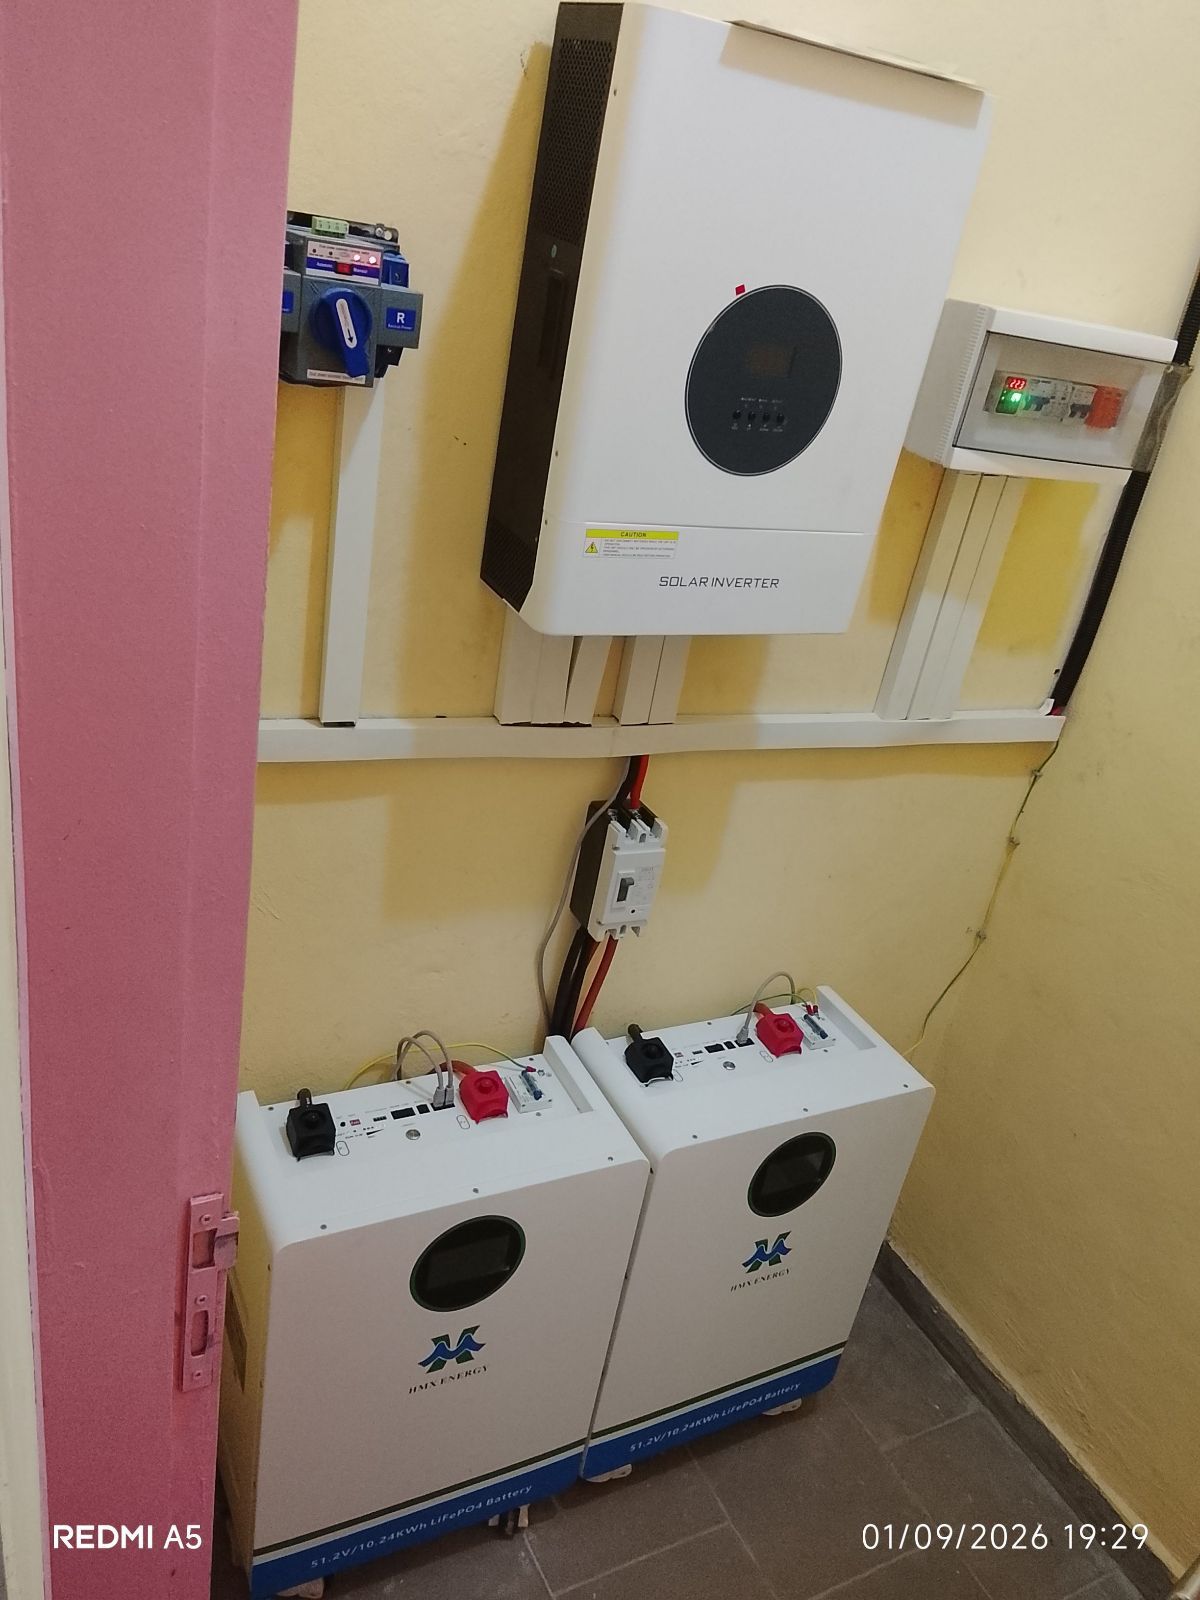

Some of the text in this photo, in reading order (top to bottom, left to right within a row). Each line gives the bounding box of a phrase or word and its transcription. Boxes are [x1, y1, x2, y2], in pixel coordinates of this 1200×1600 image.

[396, 312, 405, 324] R
[659, 576, 780, 588] SOLAR INVERTER
[754, 1267, 790, 1285] ENERGY
[408, 1365, 488, 1394] HMX ENERGY
[765, 1383, 802, 1401] Battery
[310, 1485, 533, 1569] 51.2V/10.24KWh LiFePO4 Battery
